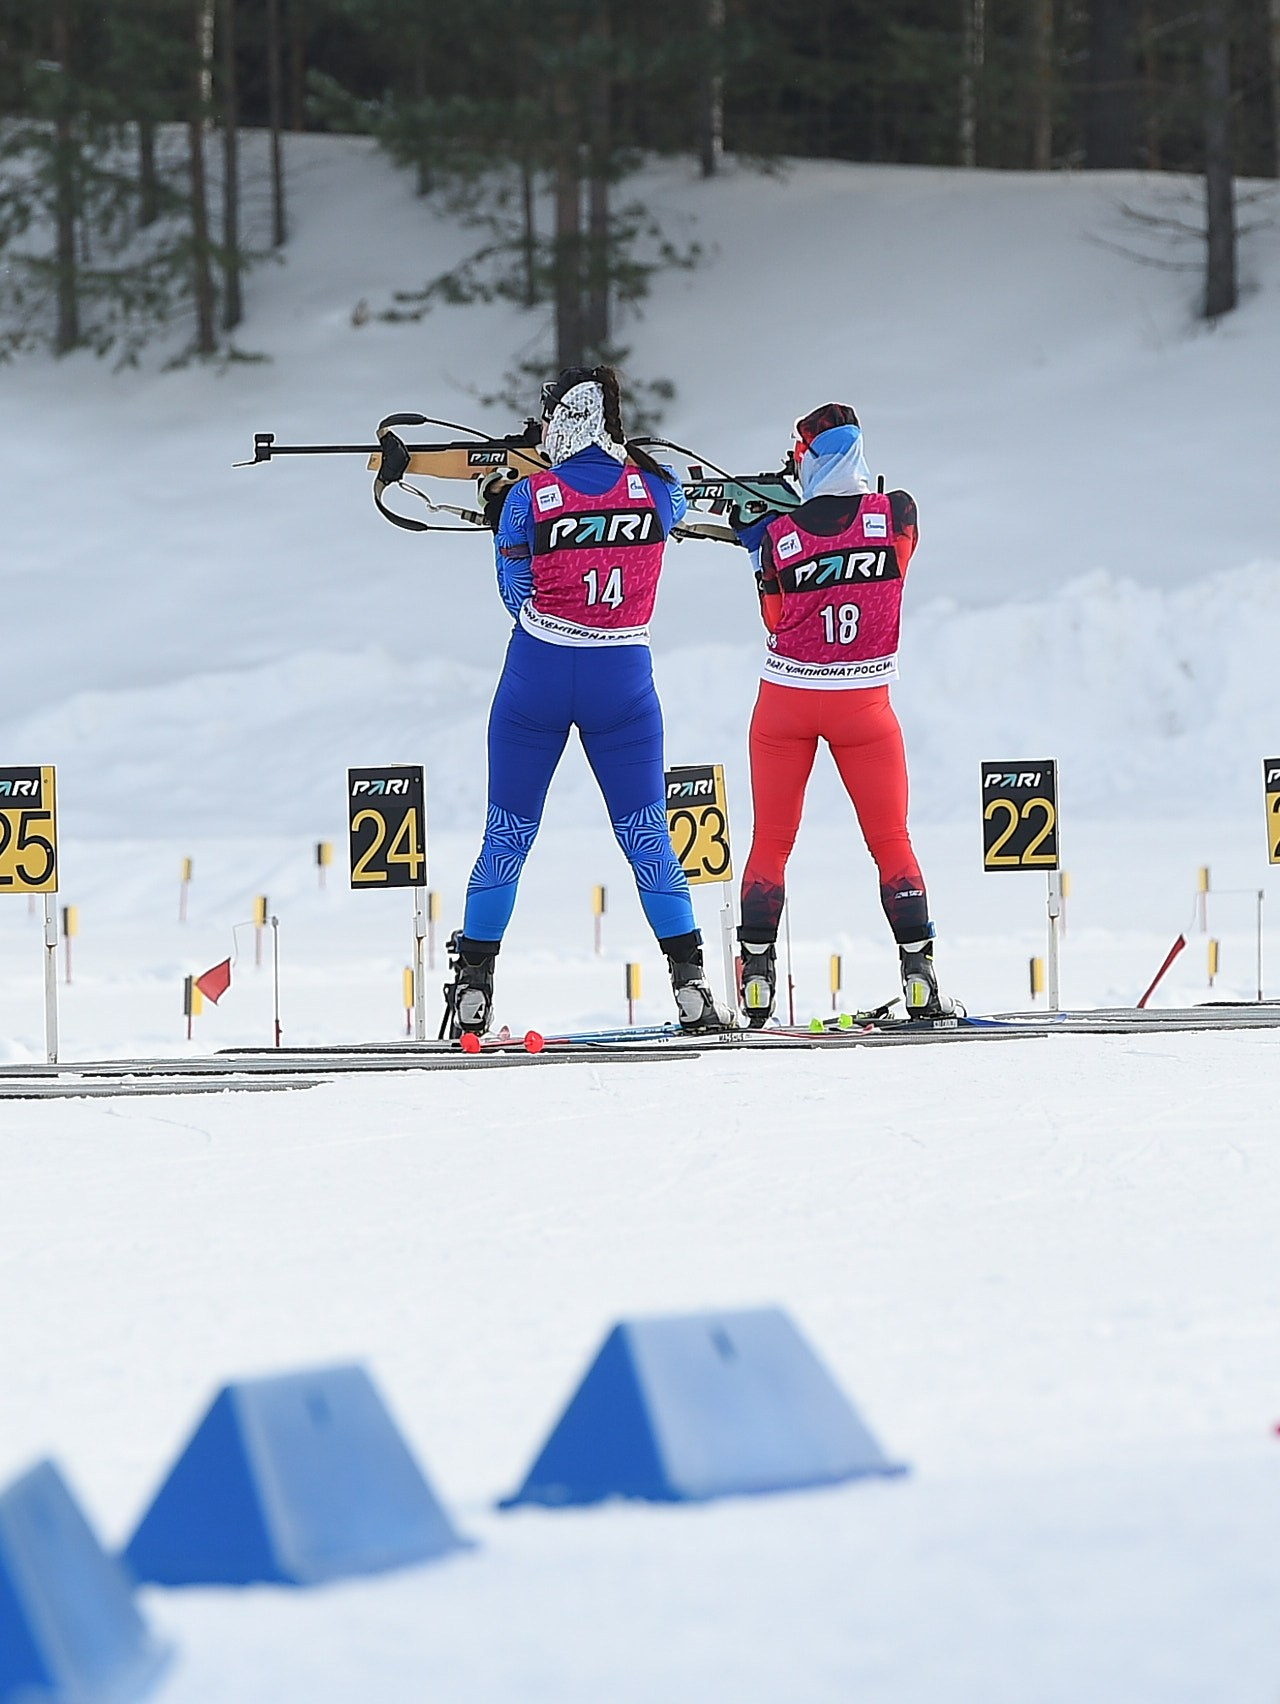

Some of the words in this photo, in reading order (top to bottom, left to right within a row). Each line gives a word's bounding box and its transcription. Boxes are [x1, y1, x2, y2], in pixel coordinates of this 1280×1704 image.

[469, 452, 505, 463] PARI
[683, 486, 723, 498] PARI
[549, 513, 653, 549] PARI
[795, 551, 887, 588] PARI
[582, 568, 624, 610] 14
[820, 603, 860, 645] 18
[0, 780, 39, 796] ARI
[352, 779, 409, 796] PARI
[667, 779, 713, 799] PARI
[984, 773, 1041, 788] PARI
[352, 807, 425, 881] 24
[669, 807, 730, 877] 23
[984, 798, 1057, 865] 22
